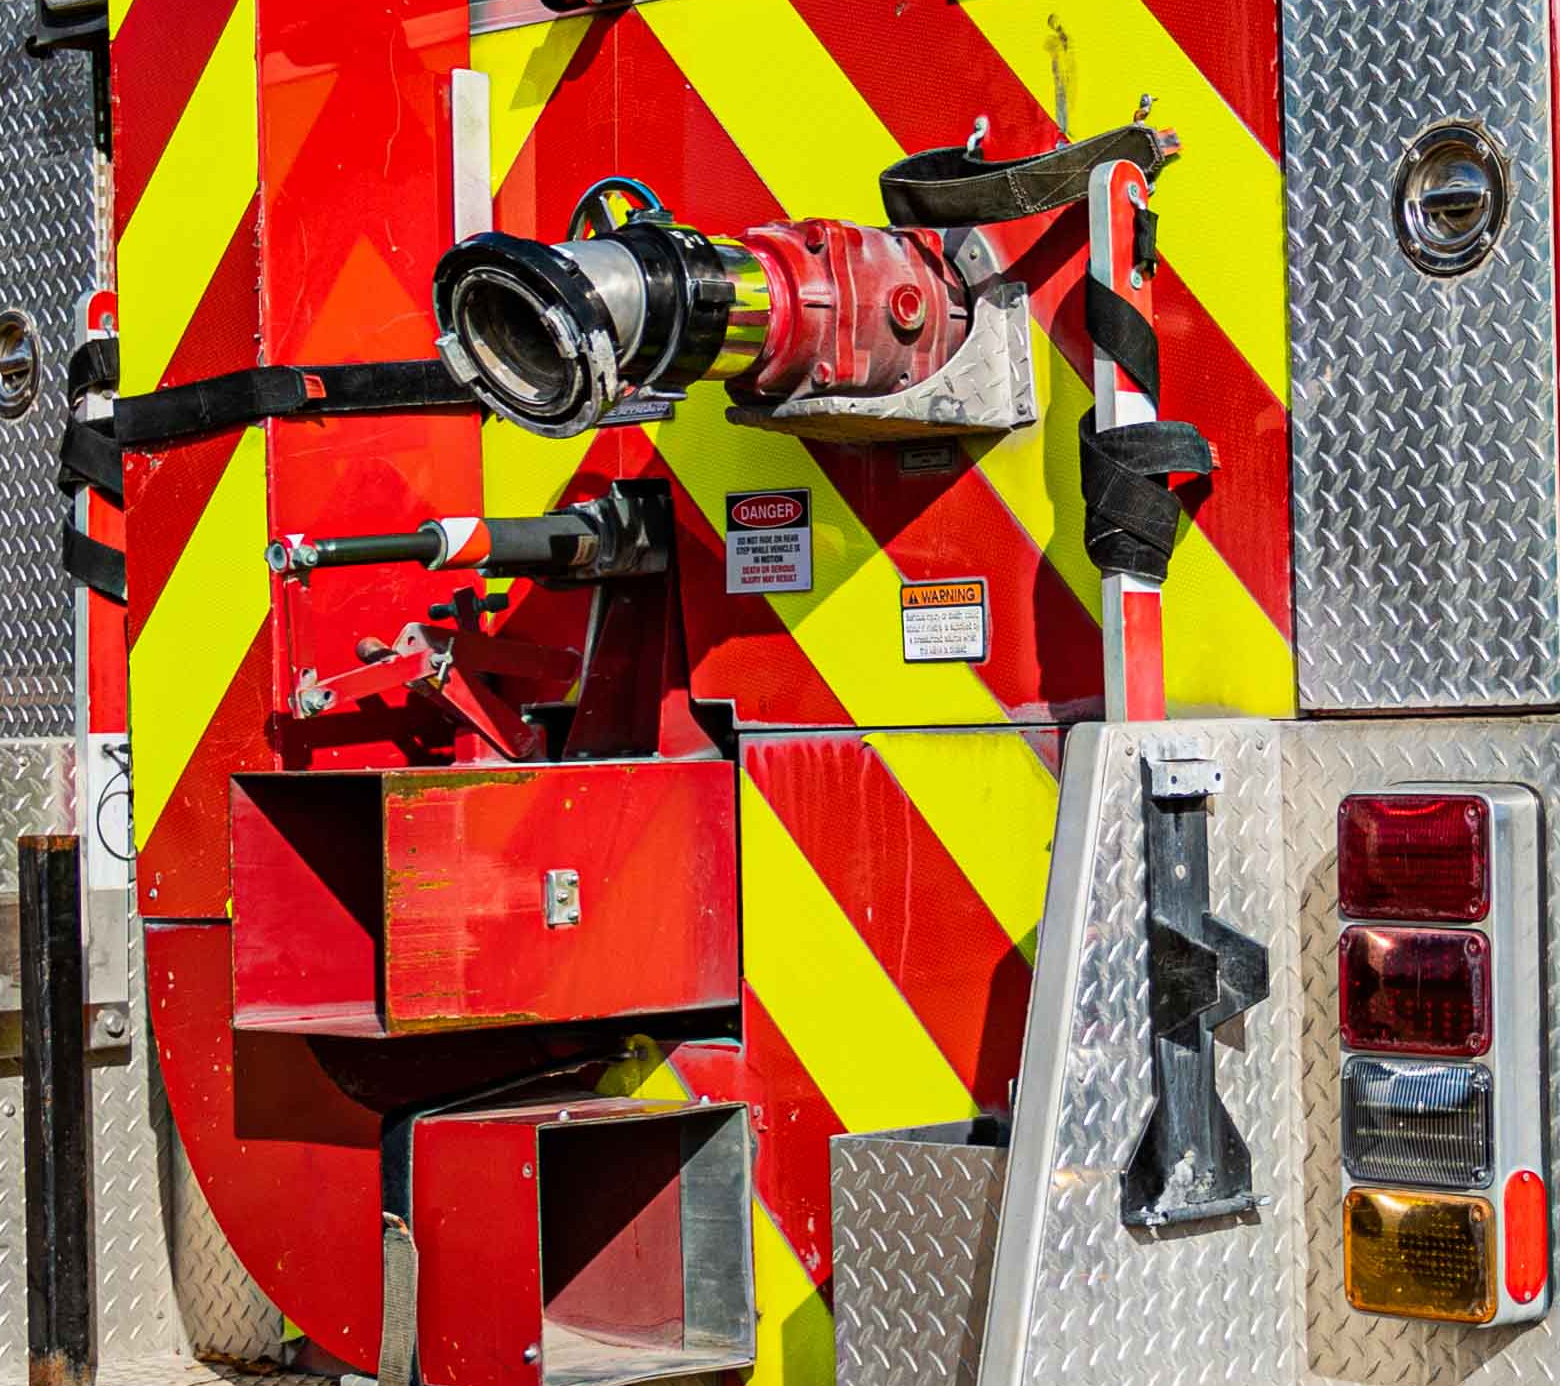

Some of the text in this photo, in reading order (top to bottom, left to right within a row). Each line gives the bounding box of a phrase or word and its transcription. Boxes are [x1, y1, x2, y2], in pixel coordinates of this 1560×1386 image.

[740, 503, 794, 520] DANGER
[747, 536, 758, 544] NOT
[760, 535, 772, 544] RIDE
[774, 535, 782, 543] ON
[784, 534, 799, 542] REAR
[736, 547, 749, 555] STEP
[752, 546, 769, 554] WHILE
[770, 544, 793, 553] VEHICLE
[761, 555, 783, 563] MOTION
[742, 564, 795, 574] DEATH OR SERIOUS
[741, 574, 797, 584] INJURY MAY RESULT
[921, 587, 975, 603] WARNING
